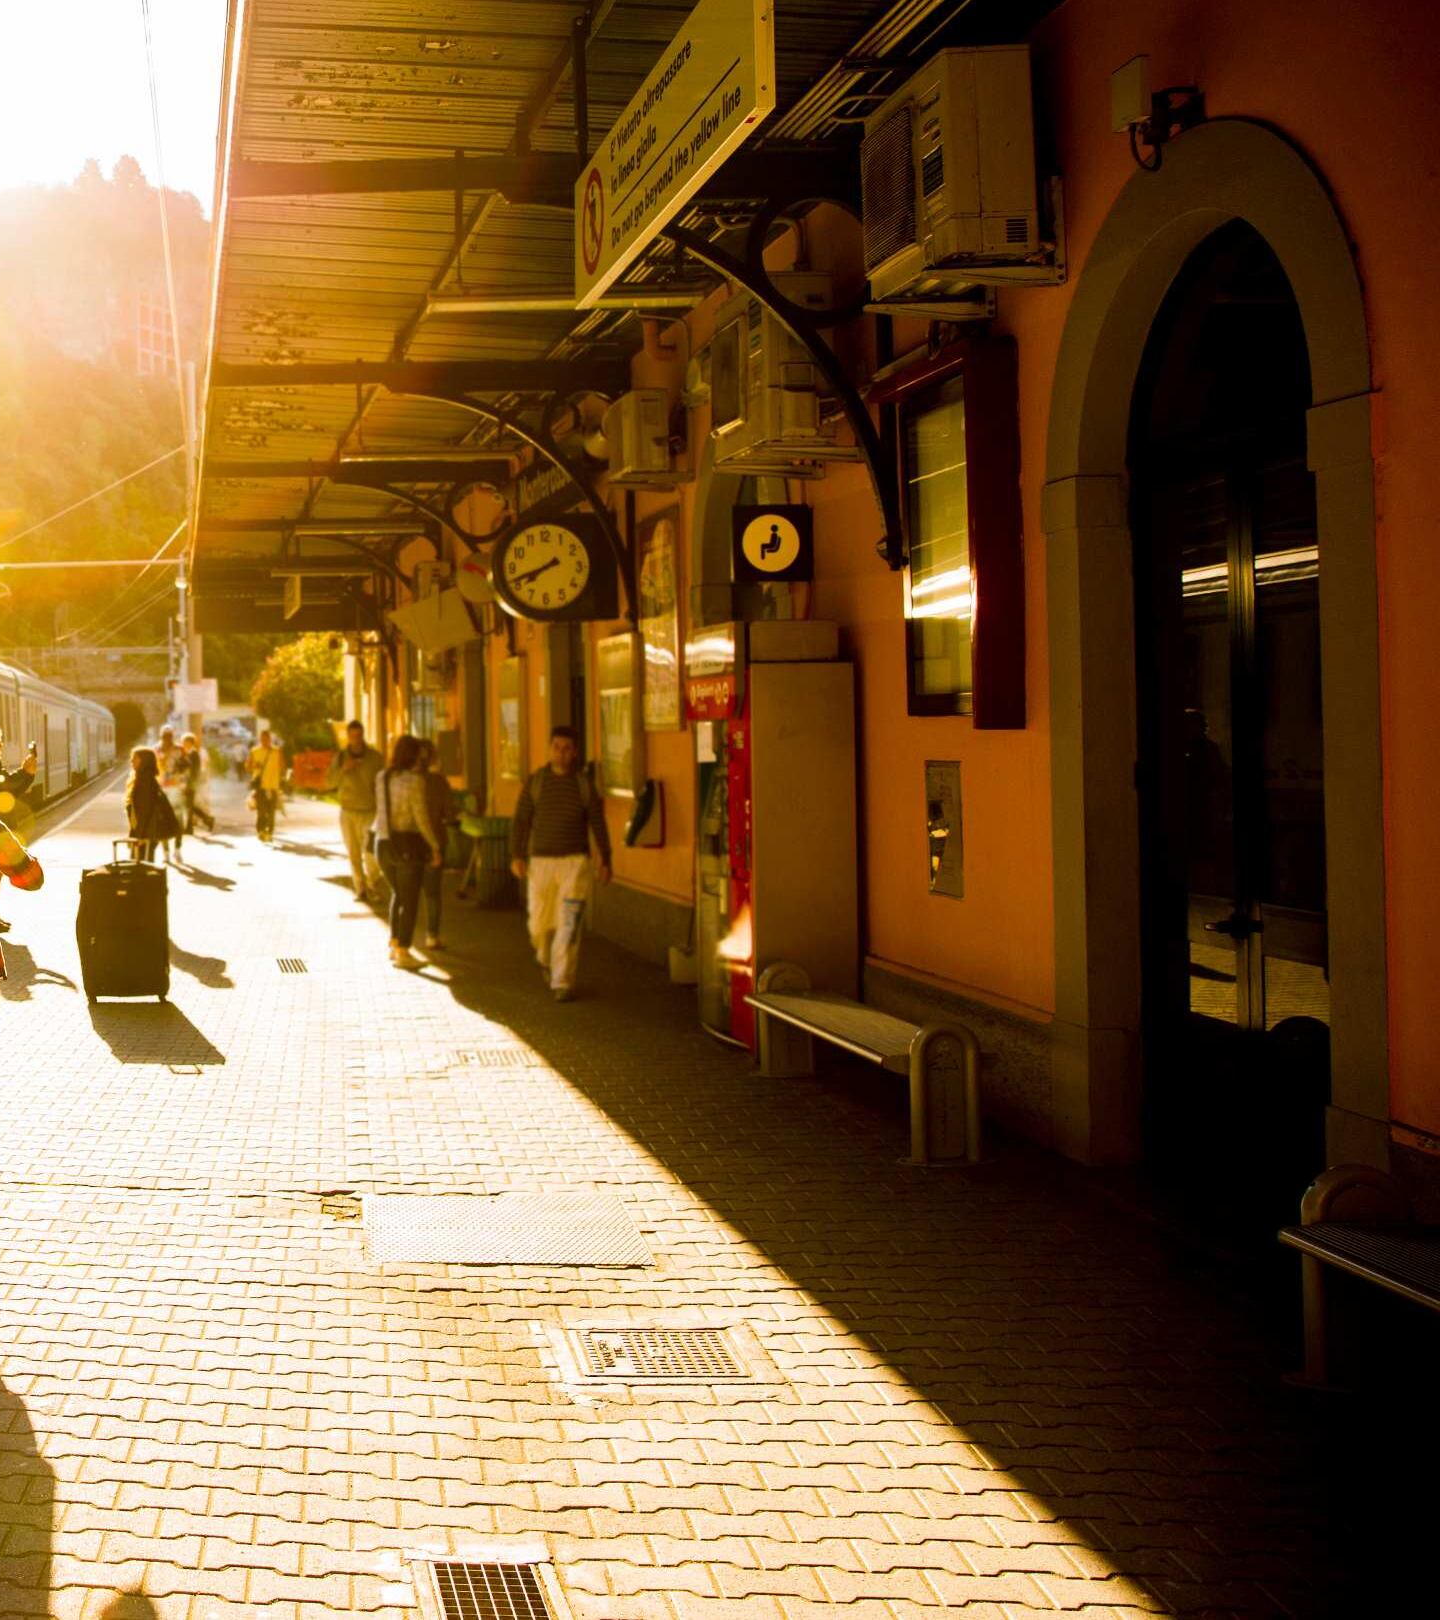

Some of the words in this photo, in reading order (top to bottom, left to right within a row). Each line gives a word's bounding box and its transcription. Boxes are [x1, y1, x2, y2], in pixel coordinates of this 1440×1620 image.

[642, 40, 691, 117] oltrepassare
[611, 176, 618, 196] la
[619, 155, 635, 186] linea
[636, 124, 656, 170] gialla
[612, 226, 620, 248] Do
[622, 209, 633, 238] not
[635, 205, 644, 227] go
[645, 157, 672, 208] beyond
[675, 147, 688, 175] the
[690, 109, 720, 164] yellow
[723, 86, 741, 120] line
[526, 534, 534, 546] 11
[540, 530, 550, 542] 12
[514, 547, 525, 559] 10
[569, 544, 576, 556] 2
[509, 562, 516, 574] 9
[576, 560, 583, 573] 3
[569, 577, 577, 588] 4
[528, 589, 535, 600] 7
[542, 593, 550, 605] 6
[558, 589, 566, 601] 5
